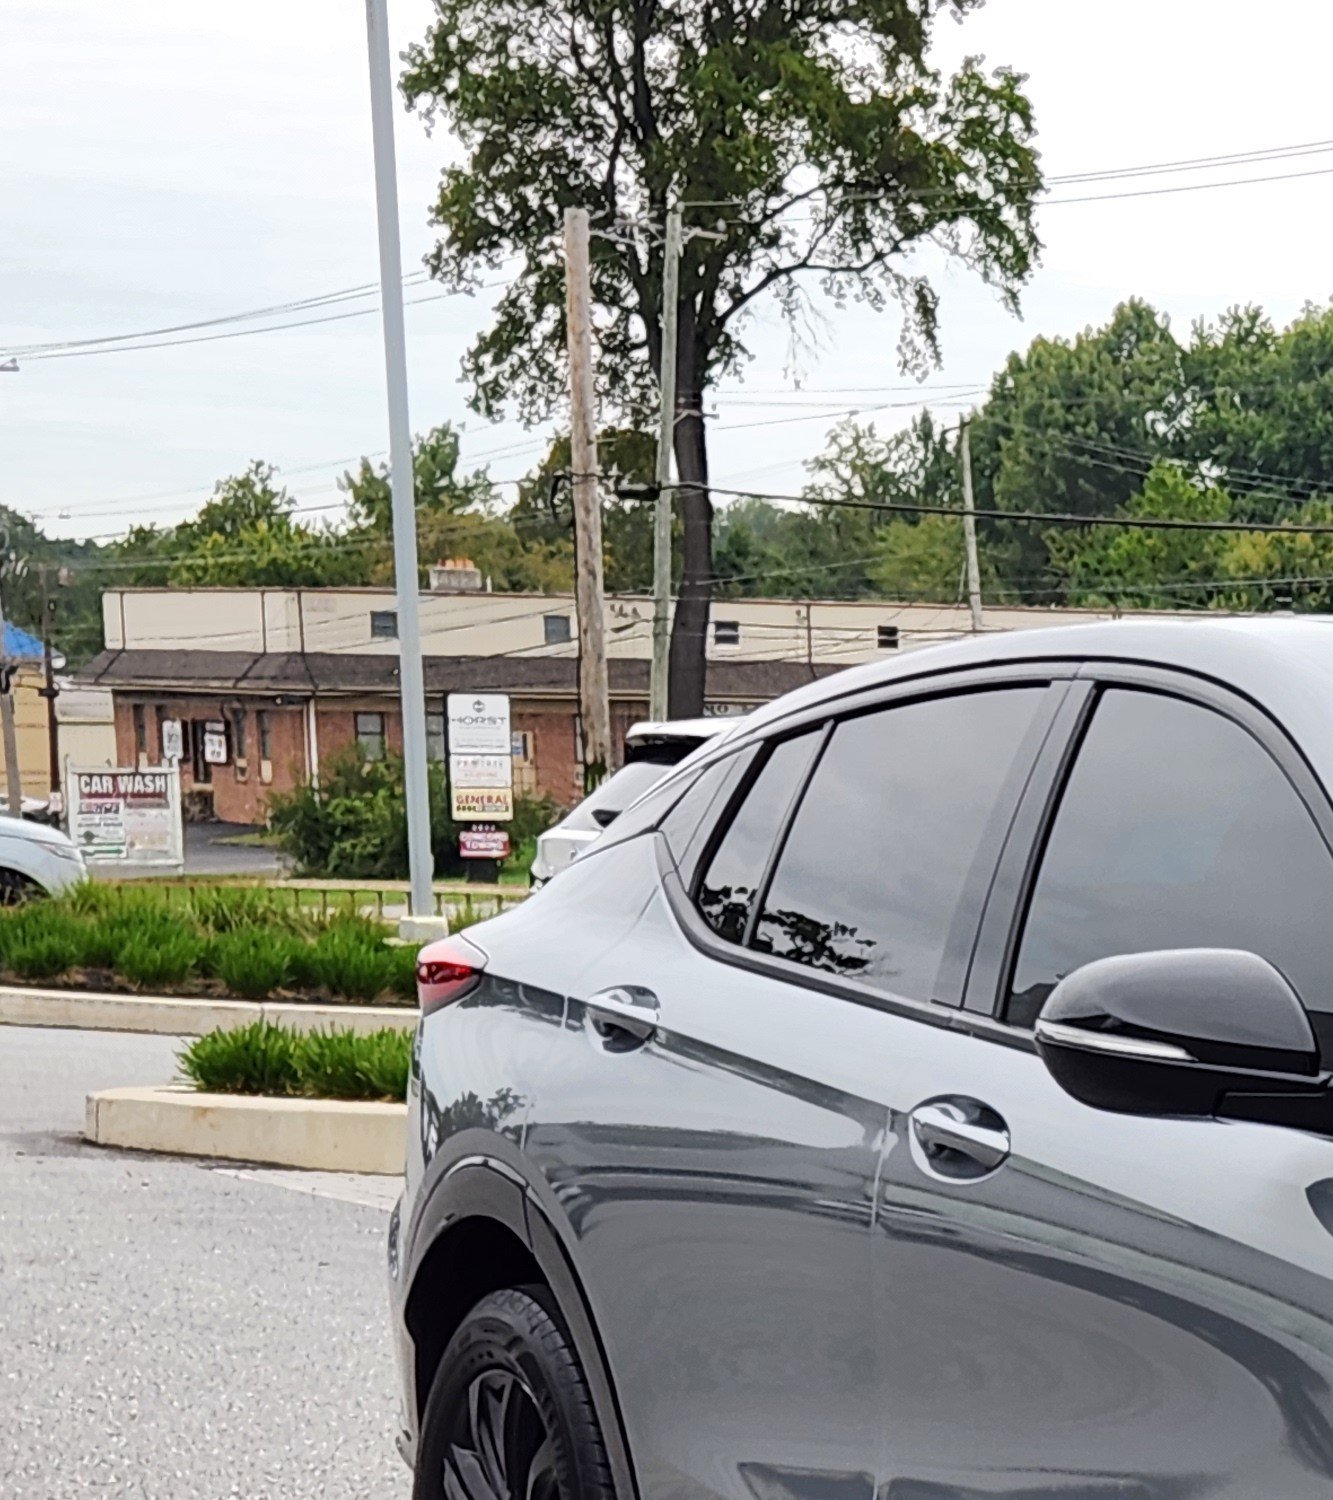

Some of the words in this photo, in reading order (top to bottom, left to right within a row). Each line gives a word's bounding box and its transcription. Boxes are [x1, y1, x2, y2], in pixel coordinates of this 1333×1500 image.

[81, 774, 114, 794] CAR
[117, 774, 166, 794] WASH
[456, 794, 507, 805] GENERAL
